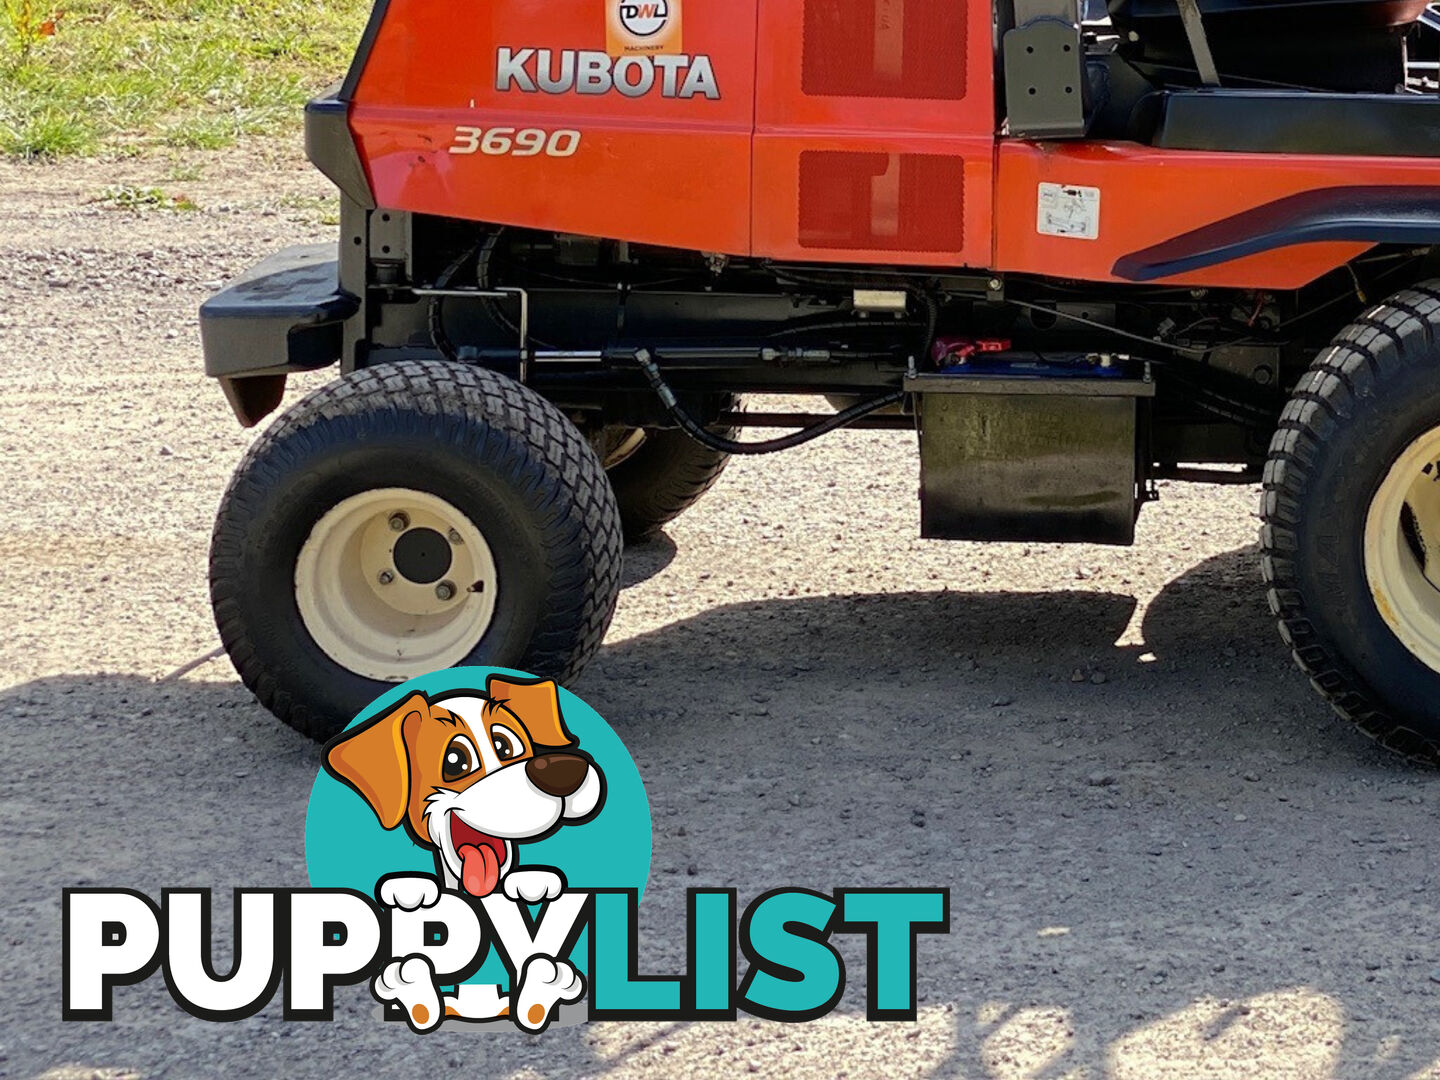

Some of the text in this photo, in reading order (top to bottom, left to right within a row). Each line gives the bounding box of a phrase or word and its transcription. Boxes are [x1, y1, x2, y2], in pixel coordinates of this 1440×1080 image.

[620, 4, 668, 19] DWL
[495, 46, 721, 100] KUBOTA
[449, 125, 582, 157] 3690
